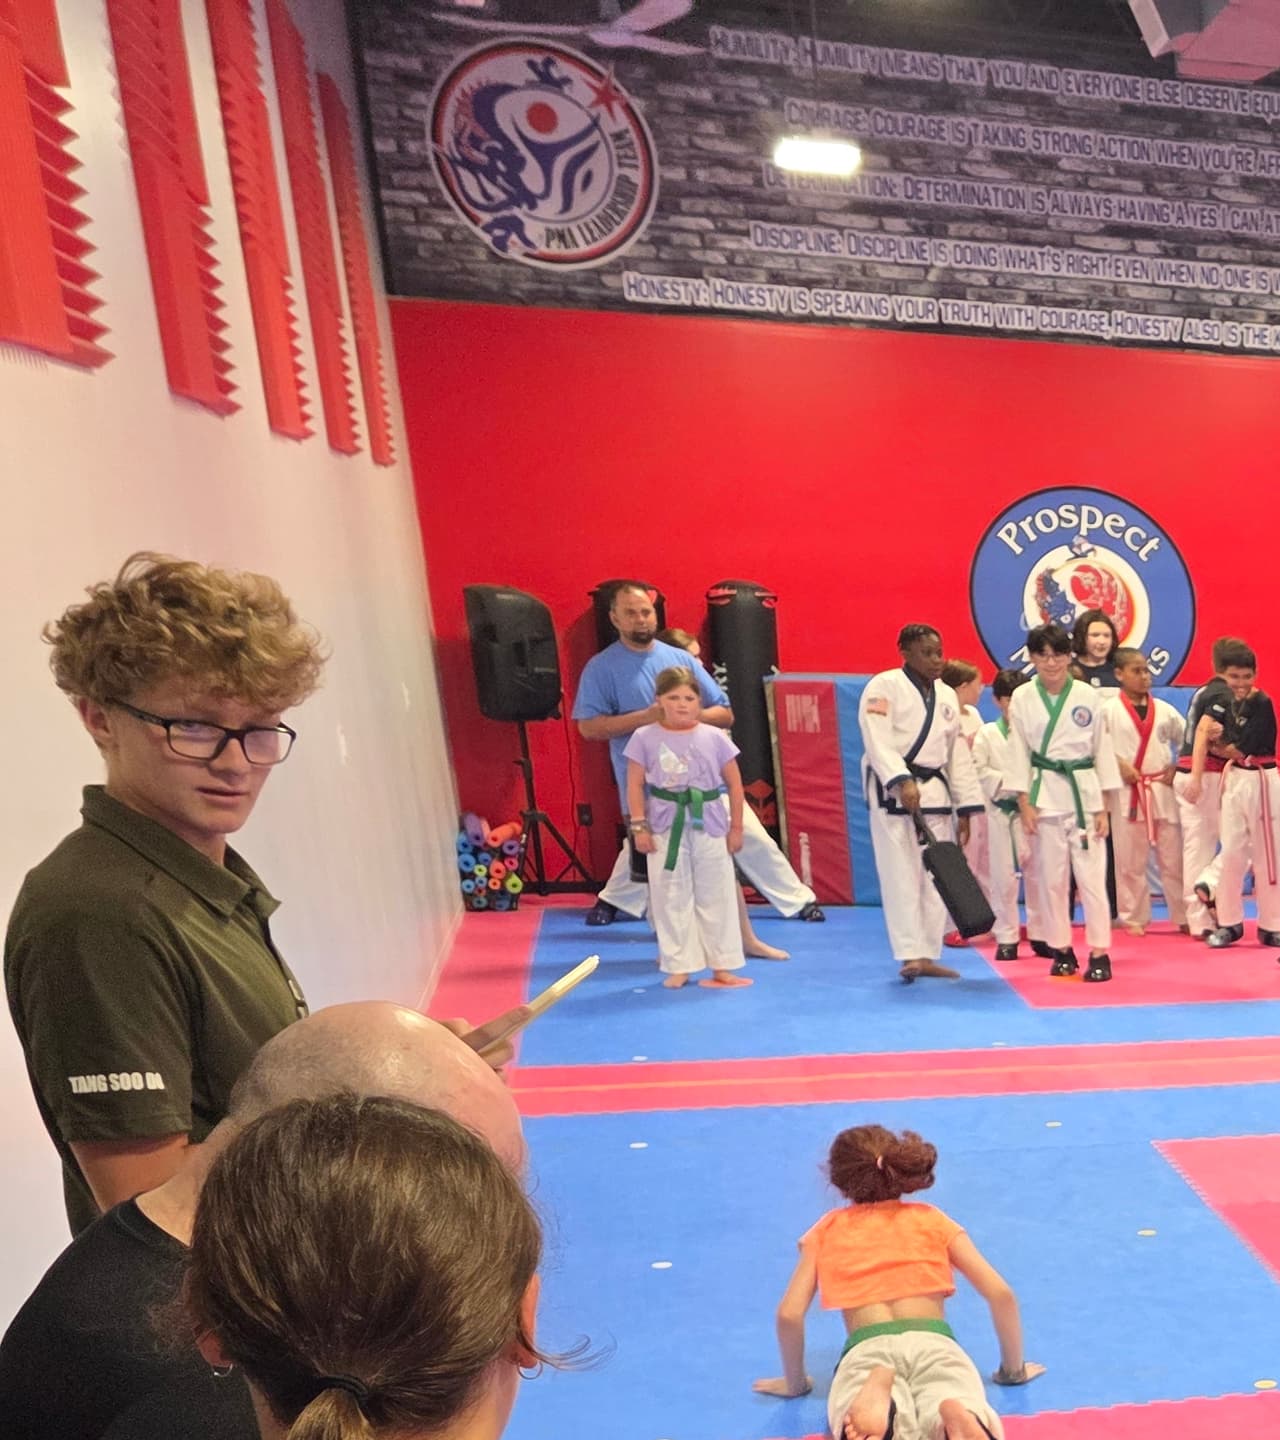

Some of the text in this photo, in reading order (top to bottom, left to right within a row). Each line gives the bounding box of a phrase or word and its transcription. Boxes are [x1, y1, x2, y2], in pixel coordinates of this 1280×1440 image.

[801, 38, 881, 73] HUMILITY
[884, 50, 941, 78] MEANS
[945, 57, 986, 82] THAT
[992, 62, 1024, 86] YOU
[1028, 66, 1060, 91] AND
[1064, 70, 1140, 99] EVERYONE
[1147, 80, 1181, 104] ELSE
[1186, 85, 1250, 113] DESERVE
[873, 110, 945, 140] COURAGE
[949, 119, 966, 143] IS
[970, 121, 1026, 149] TAKING
[1031, 129, 1092, 156] STRONG
[1098, 136, 1150, 160] ACTION
[1159, 142, 1197, 167] WHEN
[1202, 145, 1255, 172] YOU'RE
[544, 227, 580, 249] PMA
[608, 129, 639, 170] TEAM
[904, 178, 1025, 210] DETERMINATION
[1028, 188, 1045, 212] IS
[1051, 194, 1113, 218] ALWAYS
[1119, 199, 1170, 223] HAVING
[1190, 204, 1218, 228] YES
[1232, 209, 1260, 232] CAN
[753, 223, 841, 254] DISCIPLINE:
[847, 232, 929, 262] DISCIPLINE
[933, 241, 947, 263] IS
[952, 243, 998, 267] DOING
[1002, 247, 1061, 272] WHAT'S
[1066, 252, 1108, 276] RIGHT
[1114, 257, 1150, 280] EVEN
[1157, 261, 1197, 285] WHEN
[1201, 265, 1221, 286] NO
[1225, 268, 1251, 290] ONE
[1256, 270, 1270, 291] IS
[627, 277, 709, 305] HONESTY:
[712, 280, 788, 307] HONESTY
[792, 289, 808, 311] IS
[813, 291, 889, 317] SPEAKING
[895, 298, 935, 320] YOUR
[942, 302, 991, 324] TRUTH
[998, 304, 1036, 326] WITH
[1041, 308, 1112, 337] COURAGE,
[1115, 311, 1183, 338] HONESTY
[1186, 319, 1221, 342] ALSO
[1225, 323, 1239, 344] IS
[1244, 325, 1269, 347] THE
[996, 504, 1162, 562] Prospect
[68, 1073, 108, 1094] TANG
[108, 1071, 144, 1091] SOO
